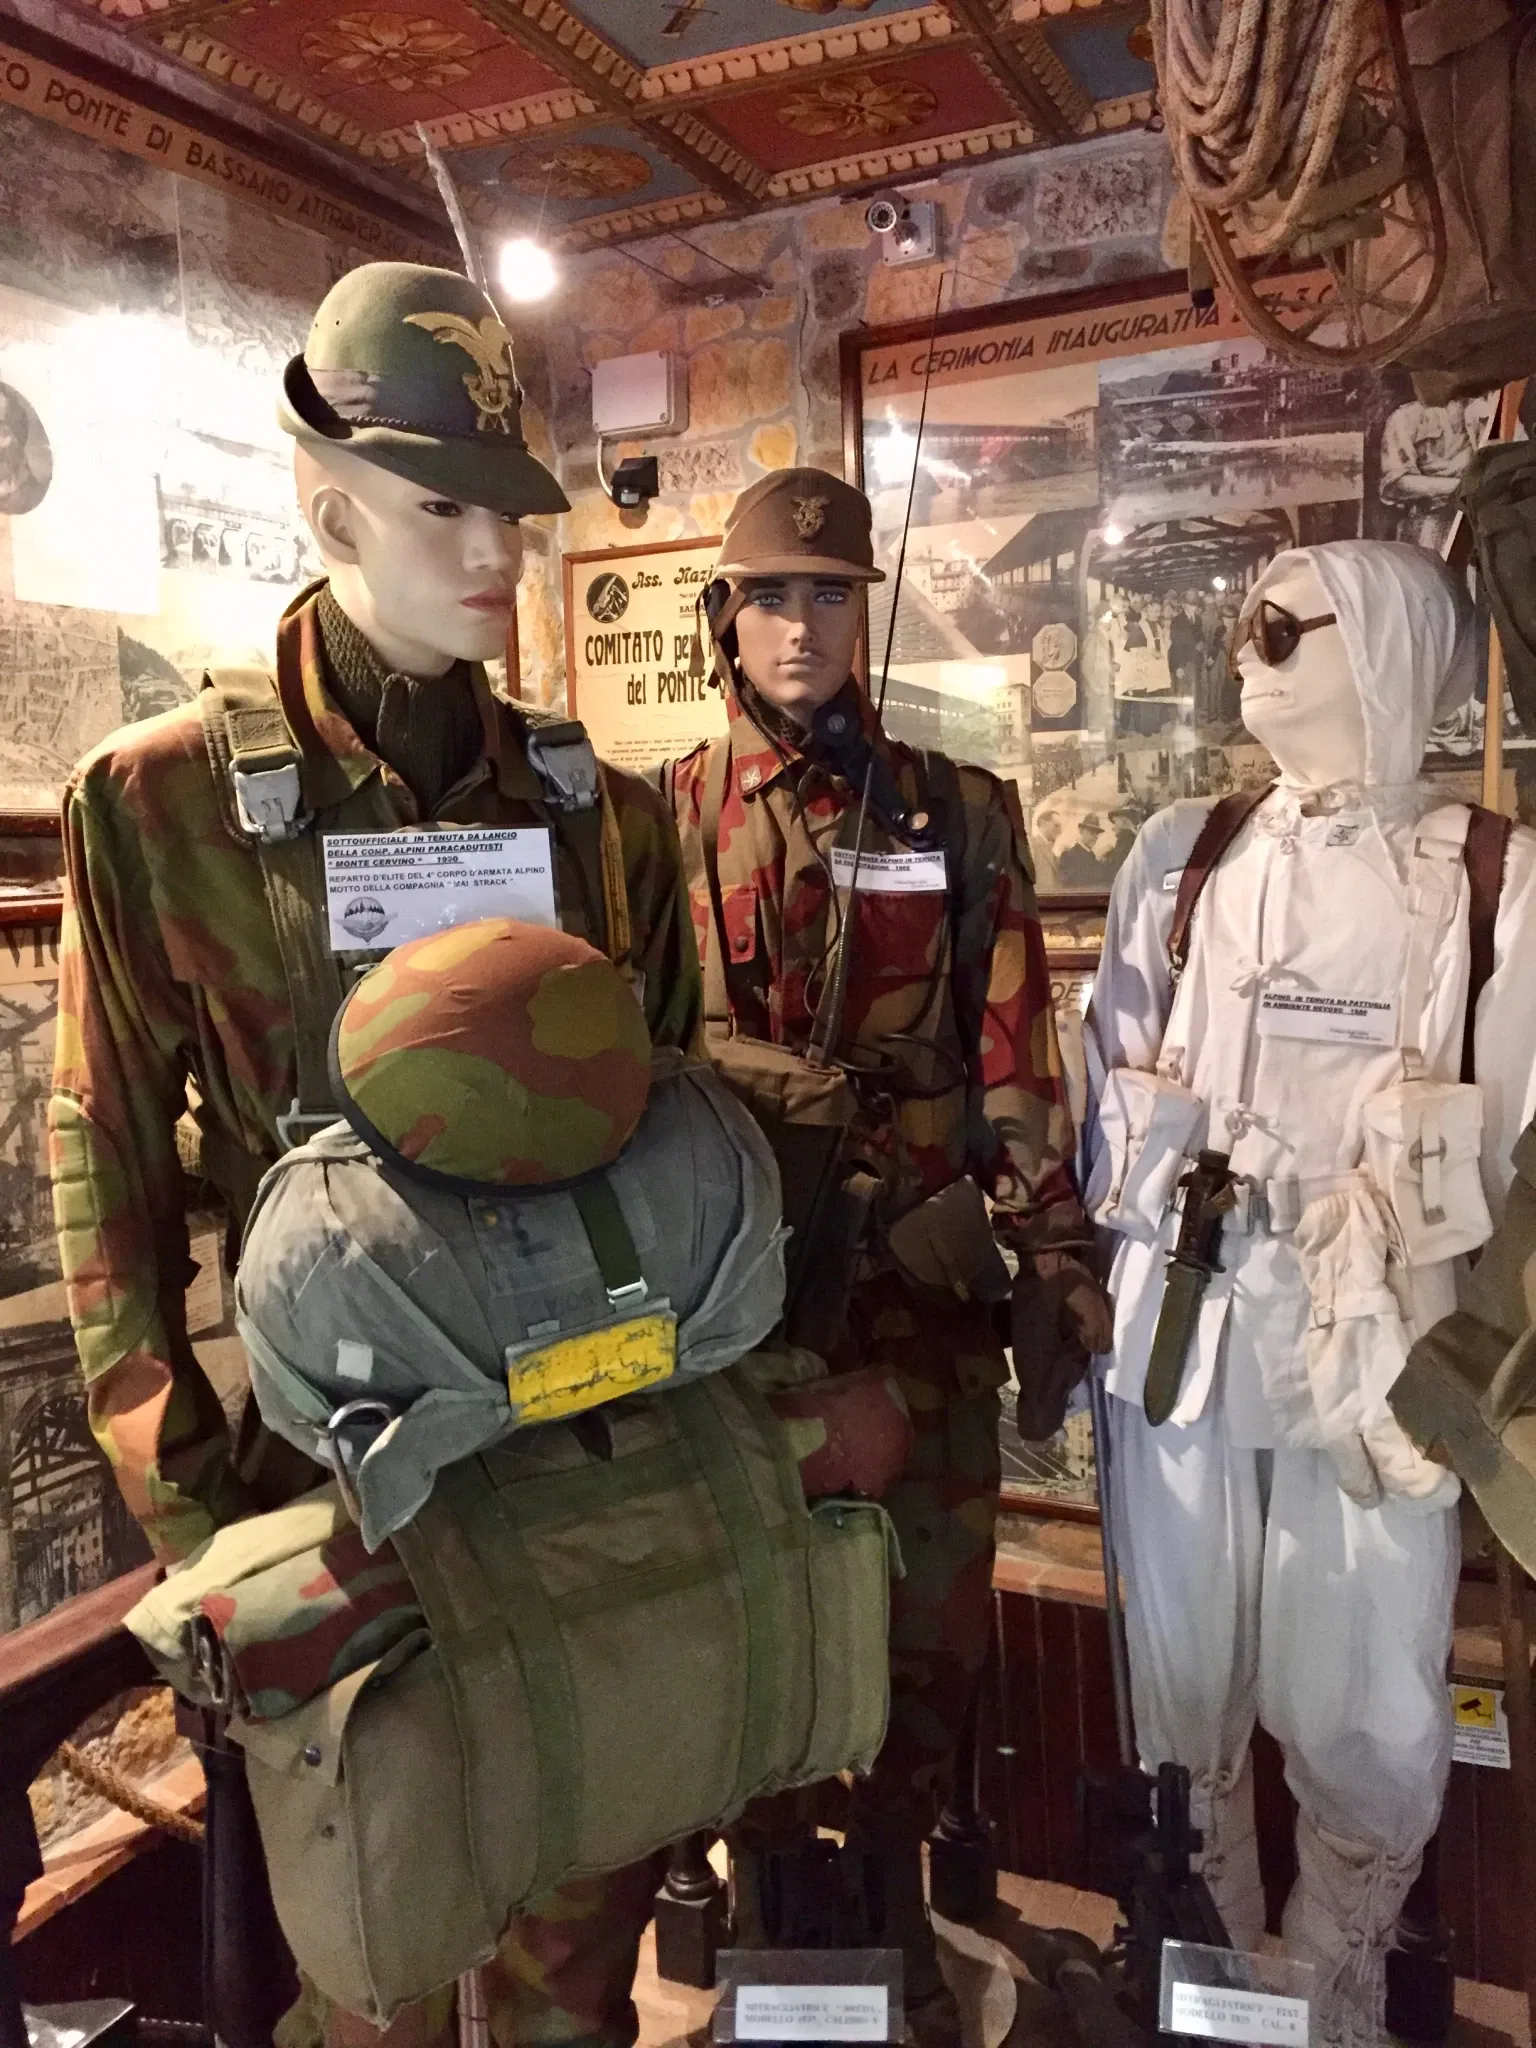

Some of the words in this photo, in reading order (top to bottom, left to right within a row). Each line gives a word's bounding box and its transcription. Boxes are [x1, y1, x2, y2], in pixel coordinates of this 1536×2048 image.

[45, 79, 131, 137] PONTE
[146, 123, 173, 154] DI
[185, 140, 292, 206] BASSANO
[868, 360, 898, 385] LA
[910, 336, 1034, 376] CERIMONIA
[1046, 302, 1219, 356] INAUGURATIVA
[632, 571, 663, 590] Ass.
[673, 563, 714, 585] Nazi
[585, 629, 664, 667] COMITATO
[627, 673, 647, 706] del
[657, 669, 707, 704] PONTE
[327, 836, 408, 846] SOTTOUFFICIALE
[414, 835, 424, 843] IN
[427, 834, 464, 842] TENUTA
[467, 833, 480, 841] DA
[482, 831, 518, 840] LANCIO
[327, 849, 358, 858] DELLA
[361, 847, 391, 856] COMP.
[394, 846, 426, 855] ALPINI
[428, 842, 503, 853] PARACADUTISTI
[336, 859, 370, 868] MONTE
[372, 857, 415, 867] CERVINO
[329, 874, 370, 883] REPARTO
[373, 872, 405, 882] D'ELITE
[407, 871, 424, 880] DEL
[437, 869, 467, 878] CORPO
[469, 868, 513, 877] D'ARMATA
[515, 866, 545, 875] ALPINO
[329, 884, 360, 894] MOTTO
[362, 883, 391, 892] DELLA
[393, 881, 445, 891] COMPAGNIA
[473, 878, 508, 887] STRACK
[1263, 993, 1291, 1001] ALPINO
[1306, 996, 1335, 1004] TENUTA
[1349, 1000, 1391, 1010] PATTUGLIA
